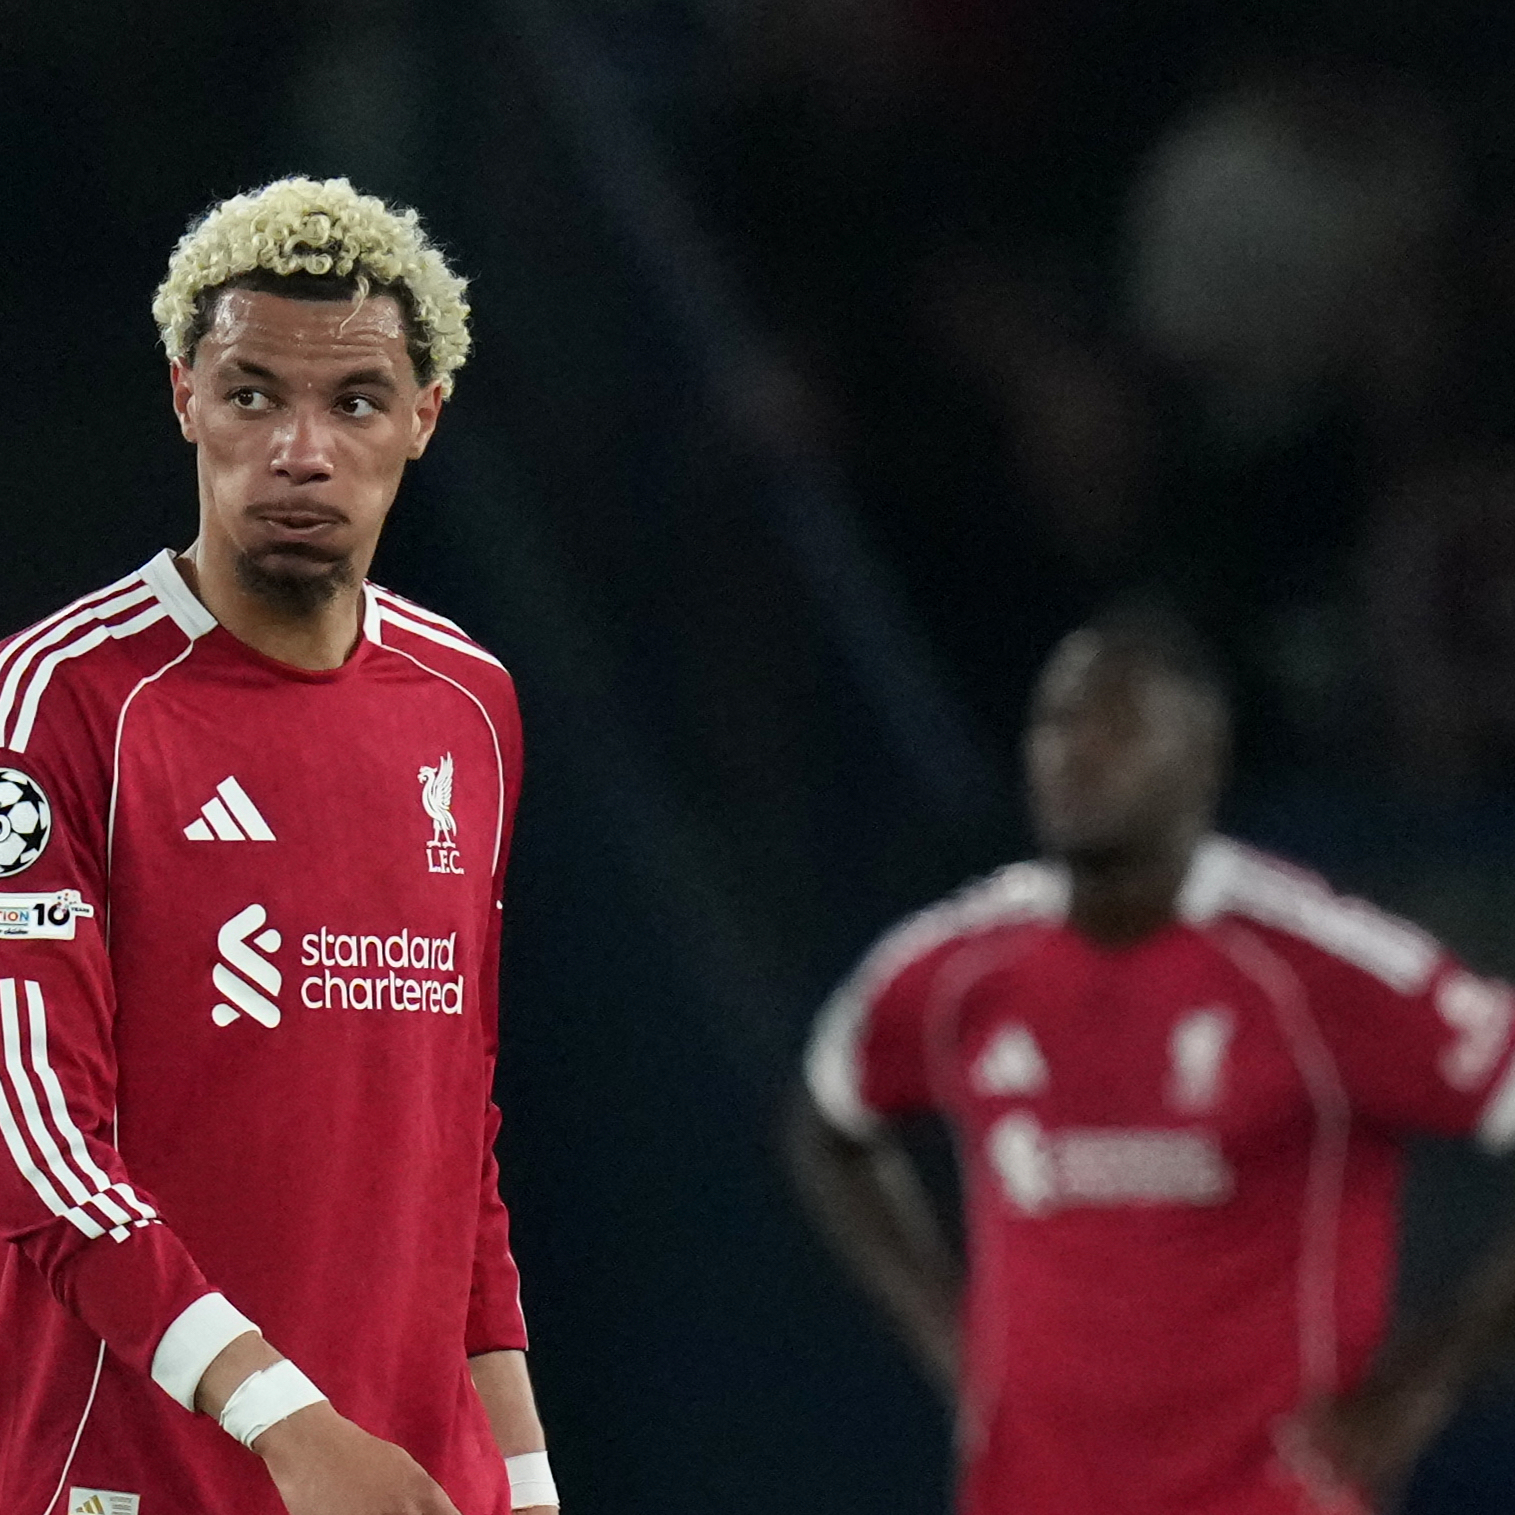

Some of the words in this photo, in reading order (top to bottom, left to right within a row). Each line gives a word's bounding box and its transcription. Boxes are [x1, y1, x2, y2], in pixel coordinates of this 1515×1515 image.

[33, 903, 71, 926] 10
[301, 925, 457, 972] standard
[300, 969, 464, 1015] chartered
